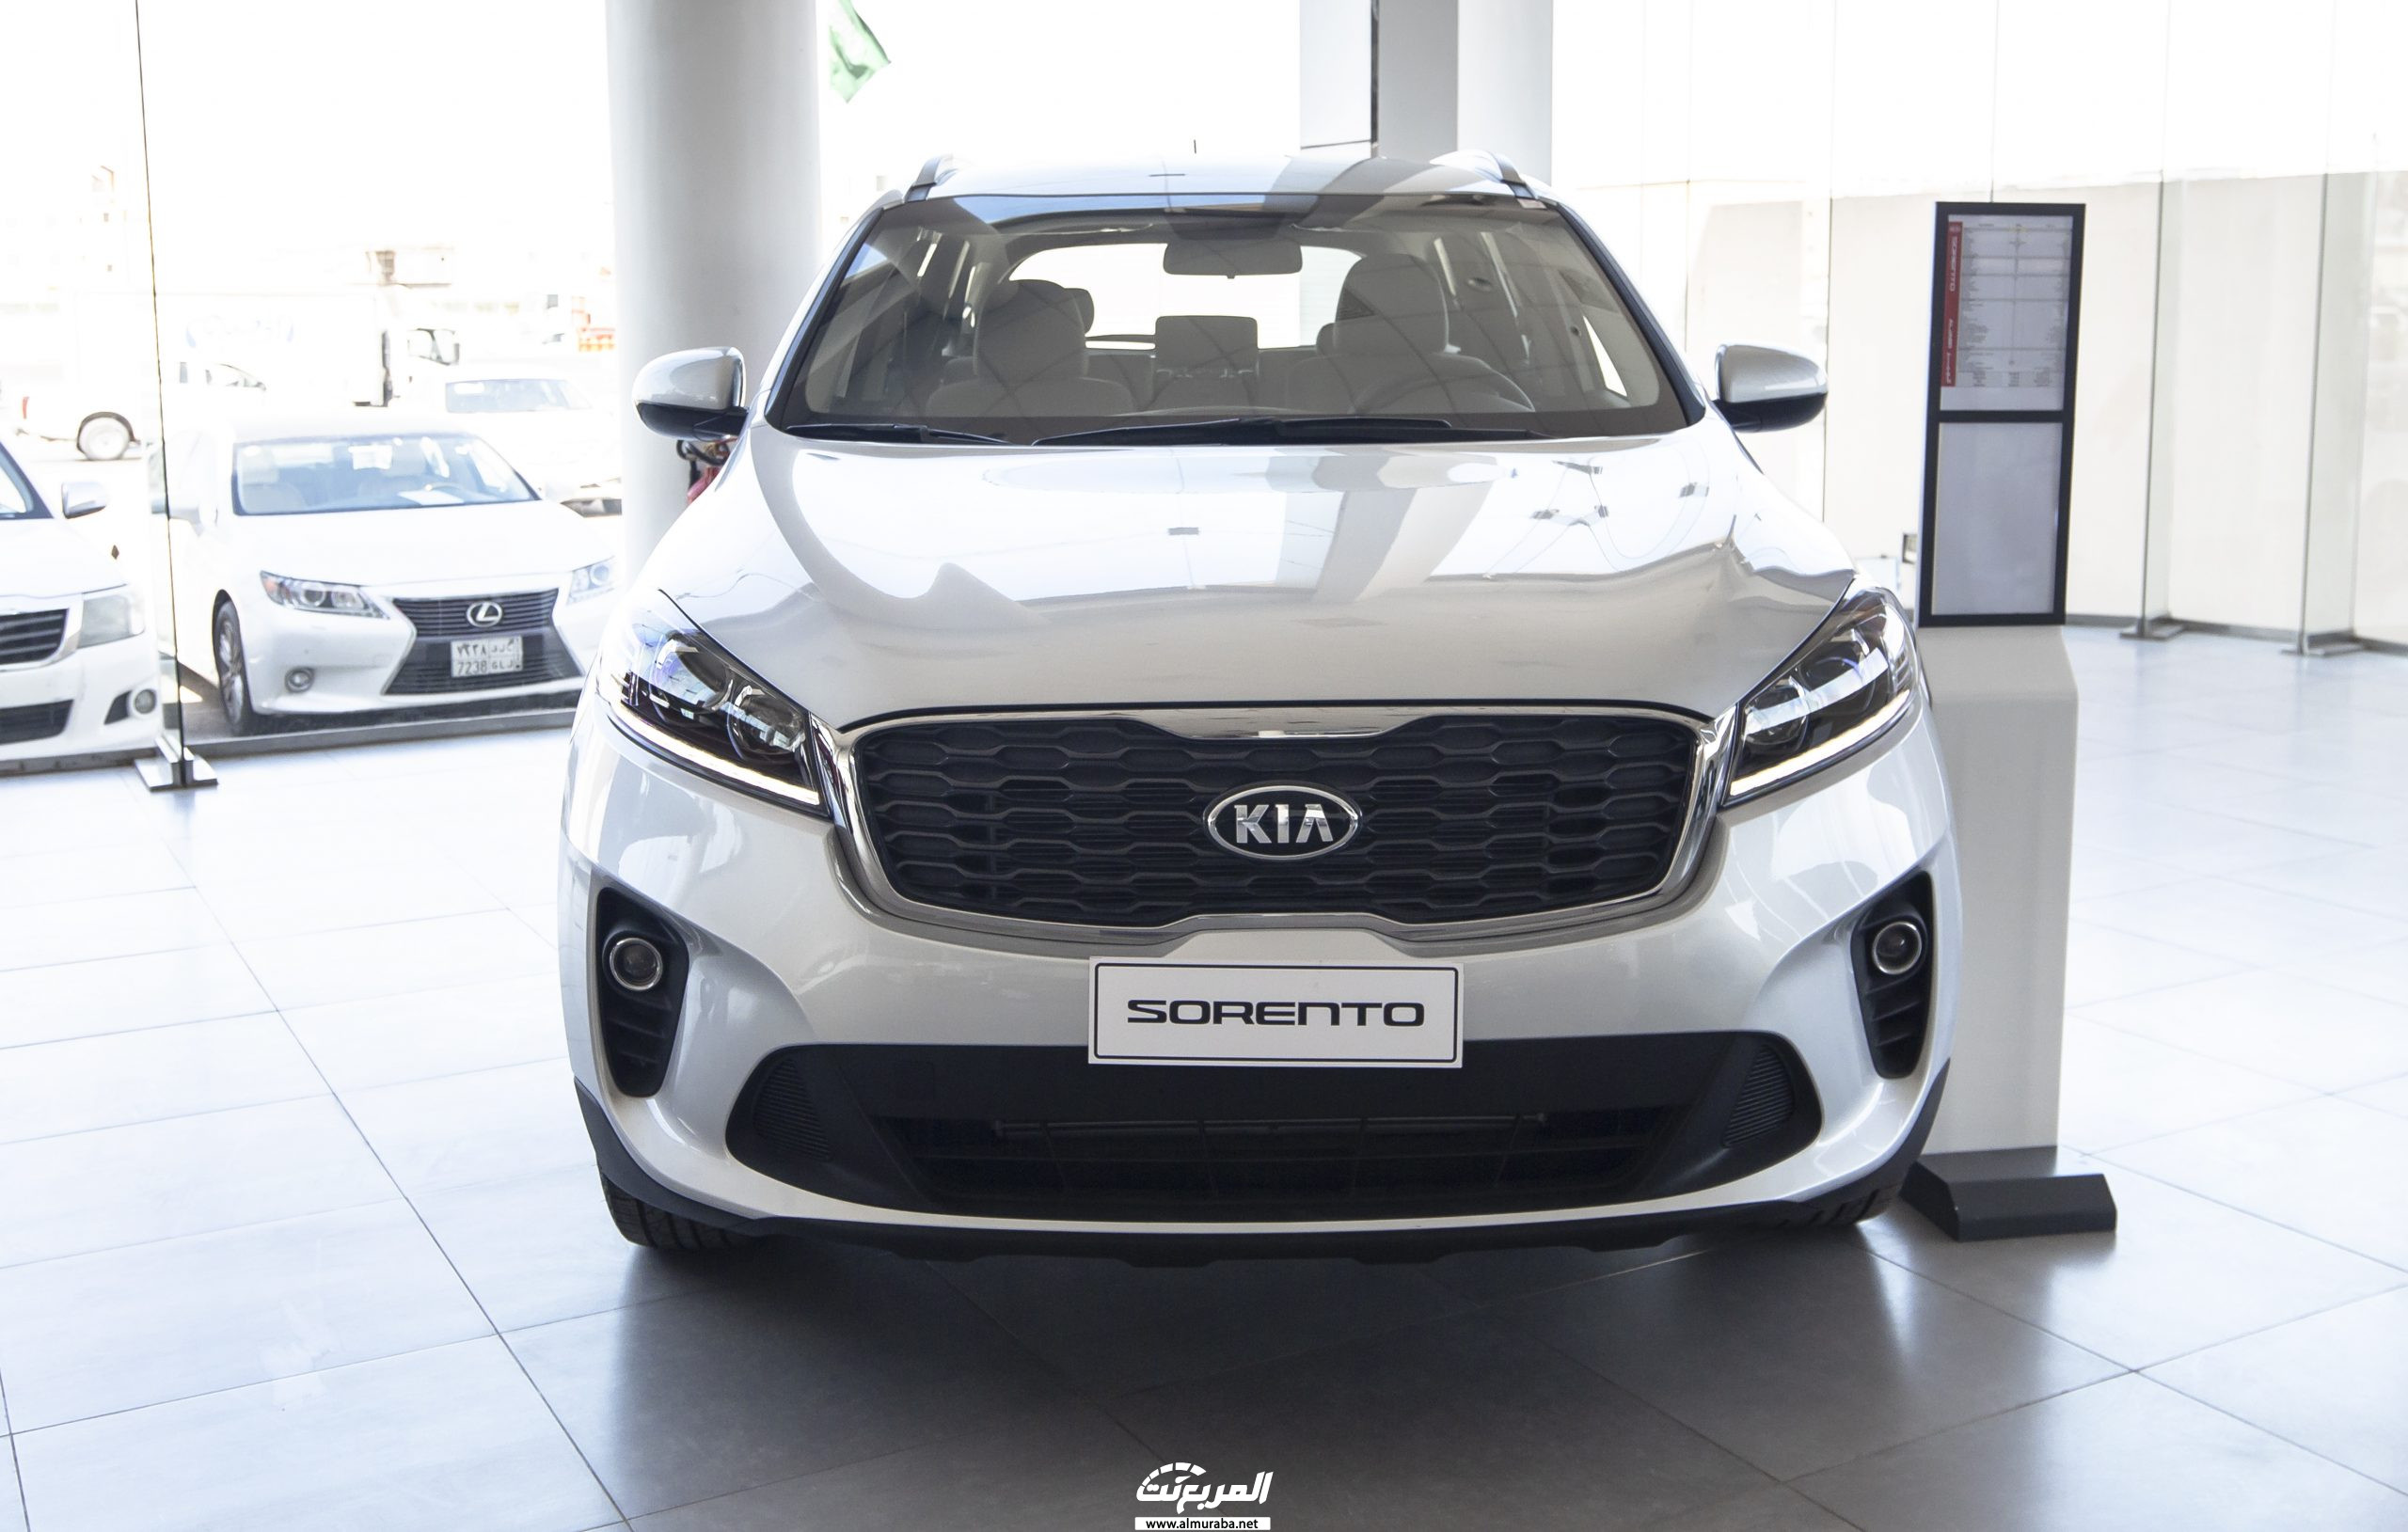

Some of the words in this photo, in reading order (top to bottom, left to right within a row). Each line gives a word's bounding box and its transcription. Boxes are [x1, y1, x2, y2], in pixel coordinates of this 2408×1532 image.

[457, 660, 488, 675] 7238
[1234, 803, 1334, 845] KIA
[1127, 999, 1425, 1027] SORENTO
